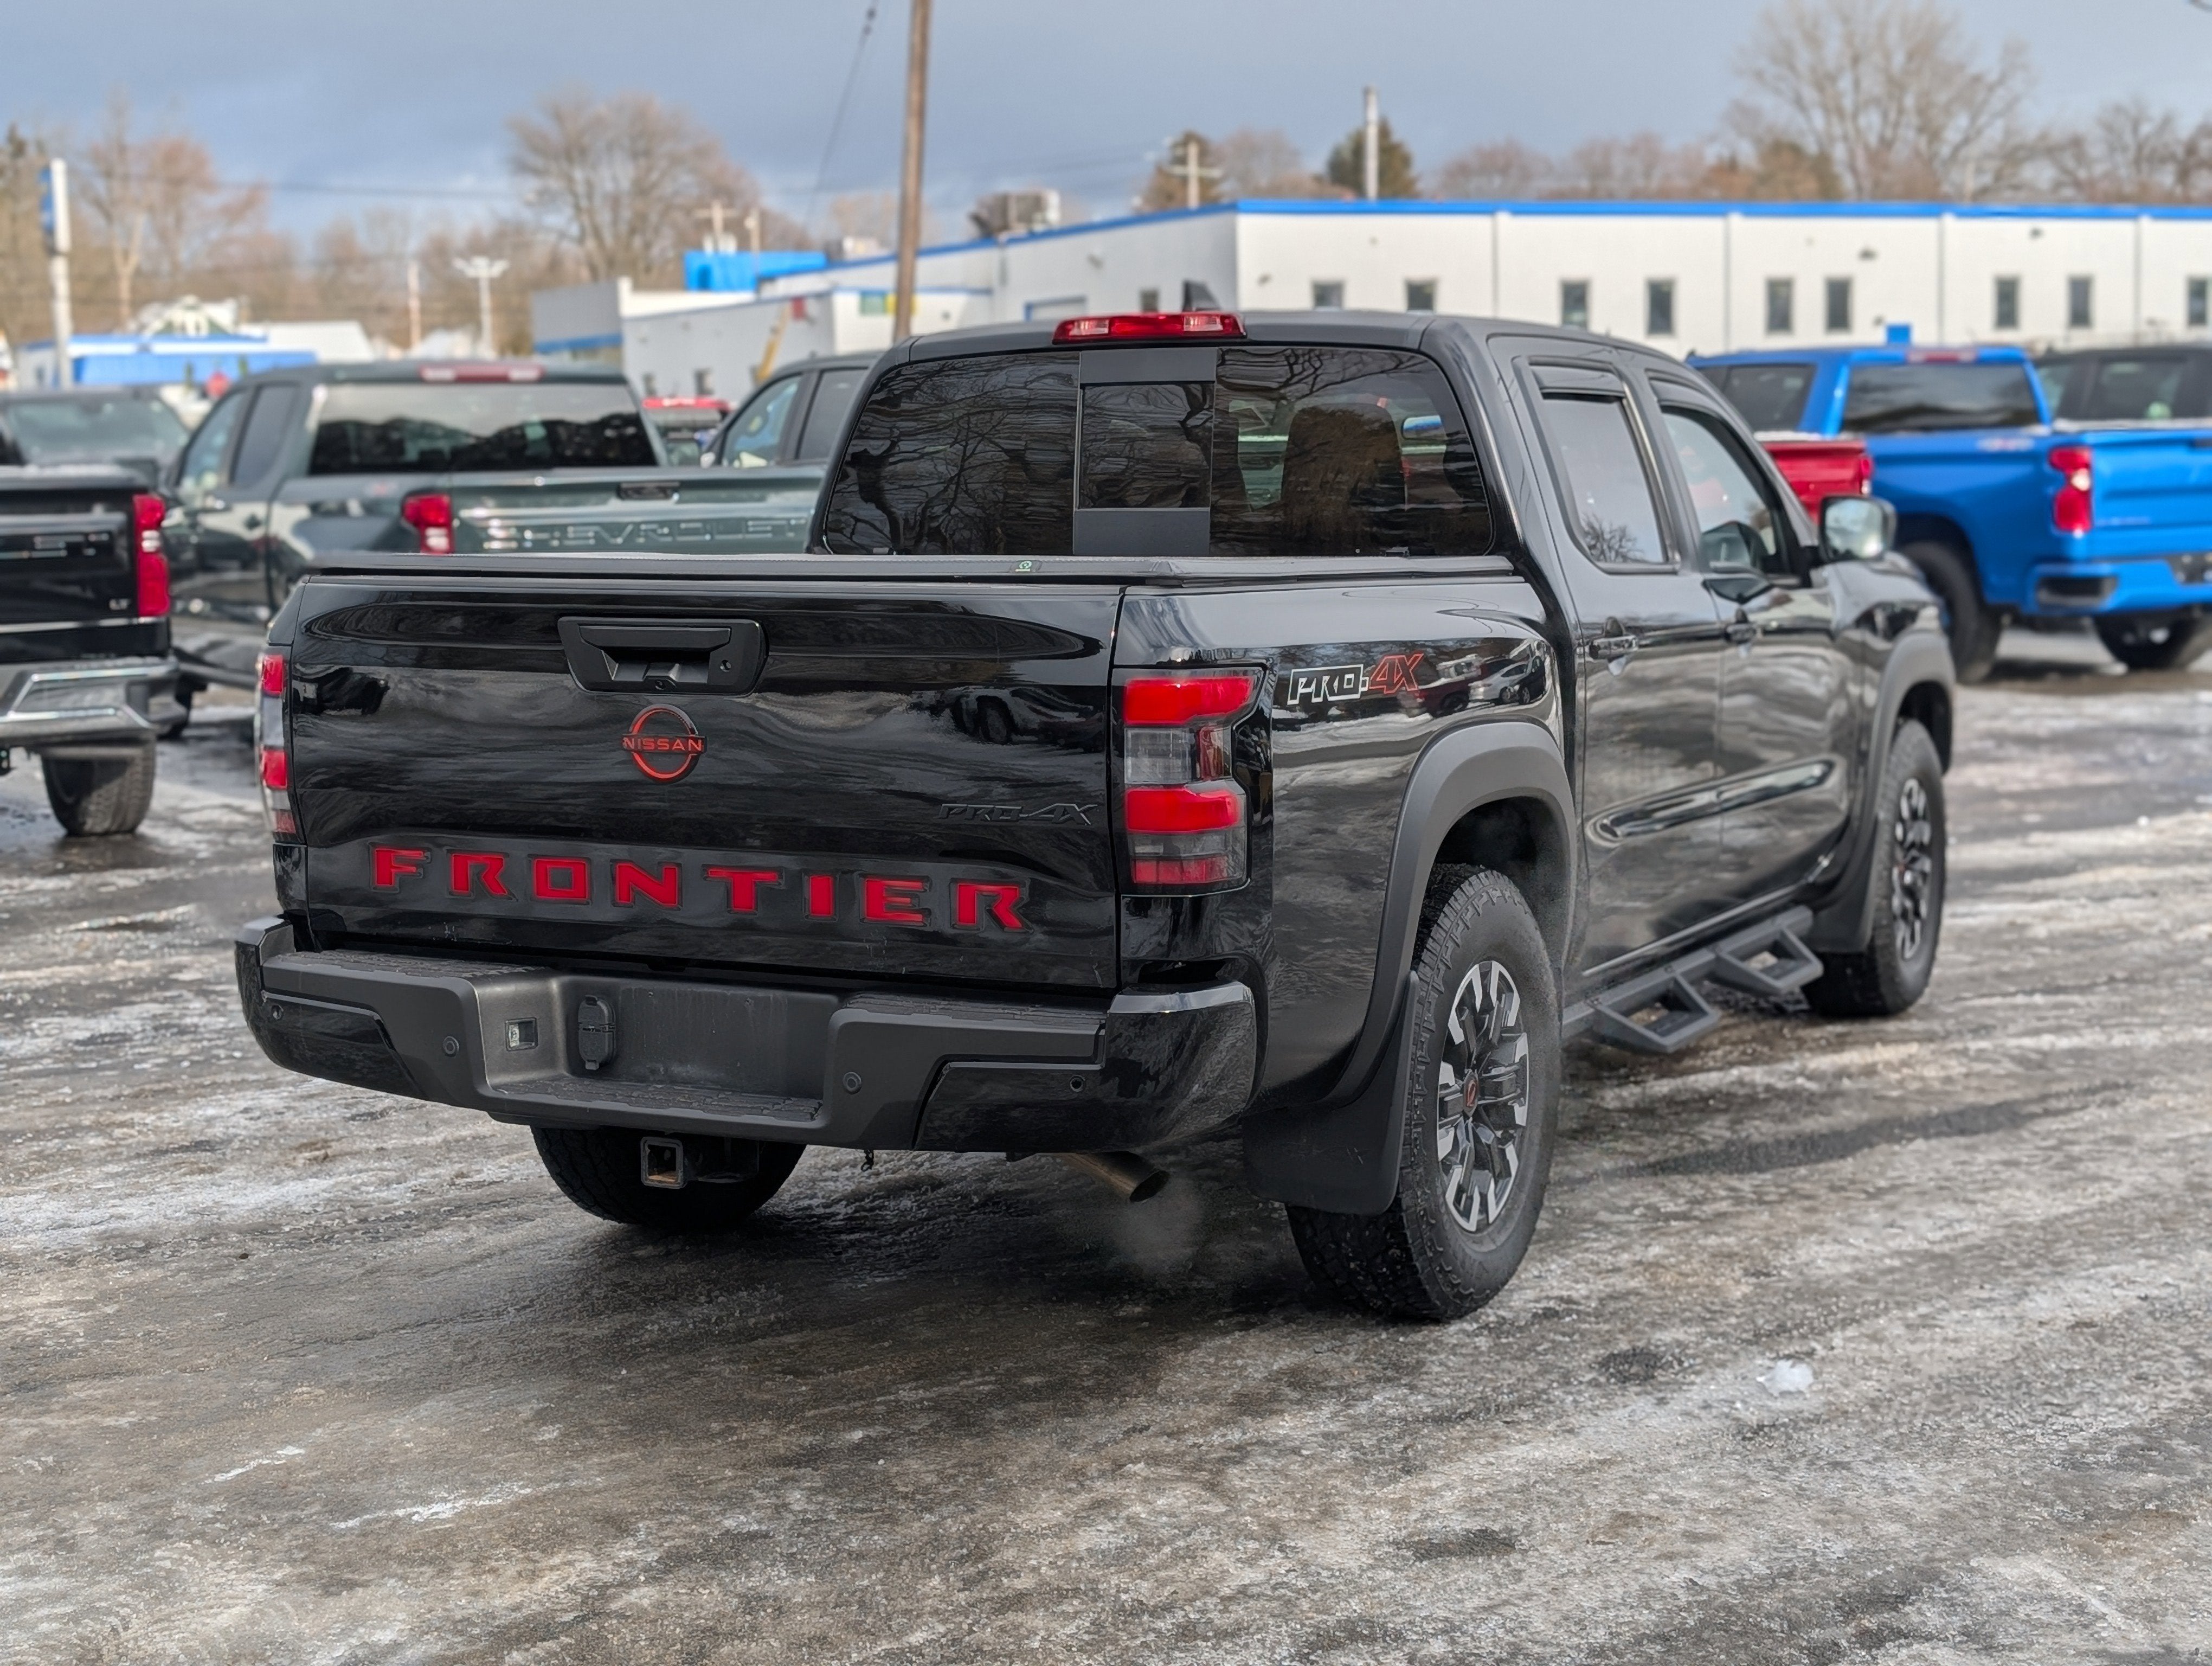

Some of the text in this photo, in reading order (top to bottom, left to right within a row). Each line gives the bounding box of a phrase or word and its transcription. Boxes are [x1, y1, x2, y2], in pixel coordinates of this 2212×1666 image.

[484, 518, 807, 547] CHEVROLET
[622, 736, 702, 752] NISSAN
[372, 845, 1030, 931] FRONTIER
